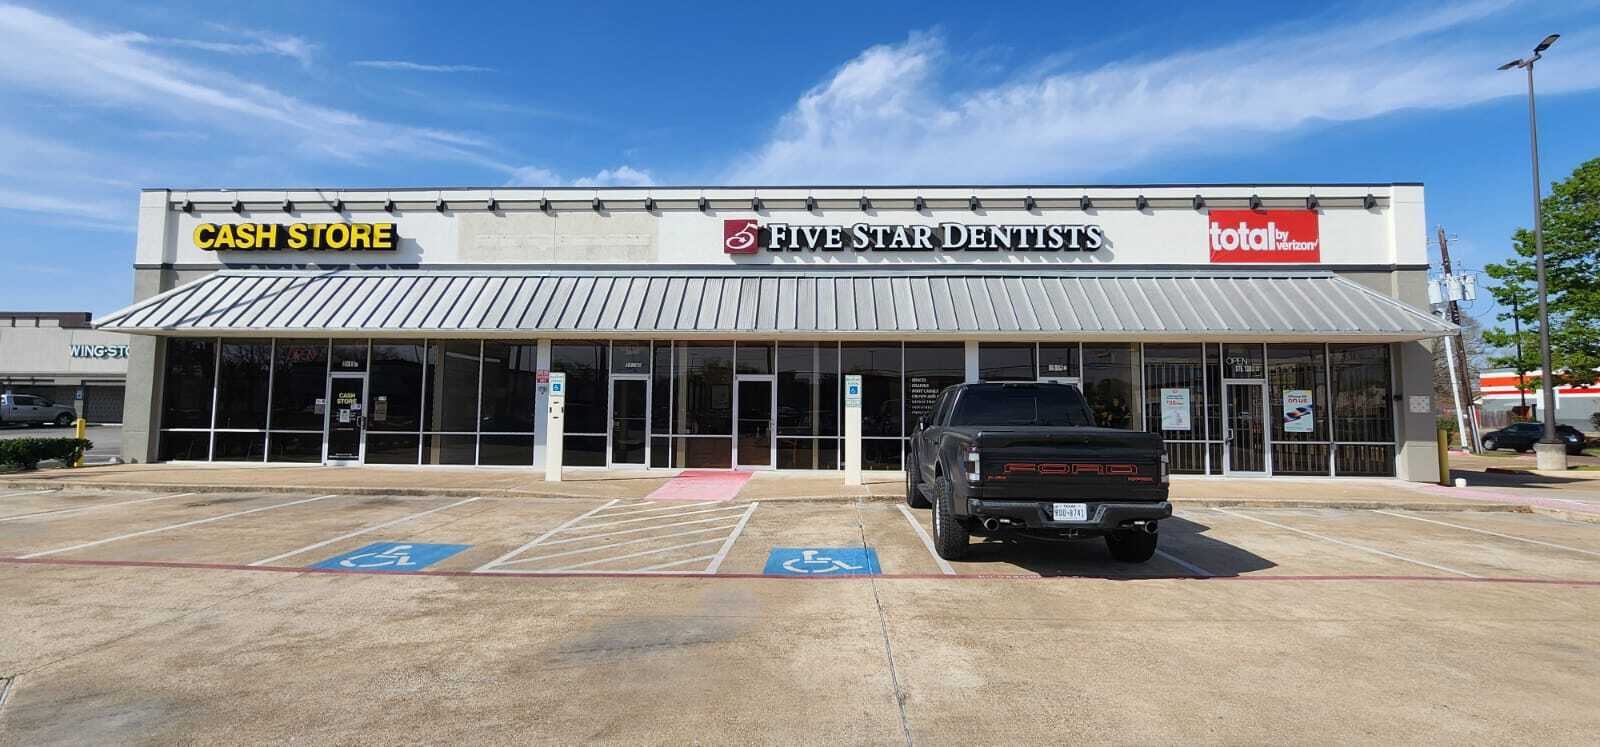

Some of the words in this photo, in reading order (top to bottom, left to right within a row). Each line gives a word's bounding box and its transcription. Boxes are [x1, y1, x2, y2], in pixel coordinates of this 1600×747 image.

[193, 223, 277, 249] CASH
[287, 223, 394, 249] STORE
[768, 223, 843, 250] FIVE
[852, 222, 934, 250] STAR
[941, 222, 1103, 250] DENTISTS
[1209, 221, 1276, 251] total
[1275, 228, 1288, 240] by
[1276, 240, 1314, 251] verizon
[1225, 357, 1248, 365] OPEN
[1004, 463, 1138, 475] FORD
